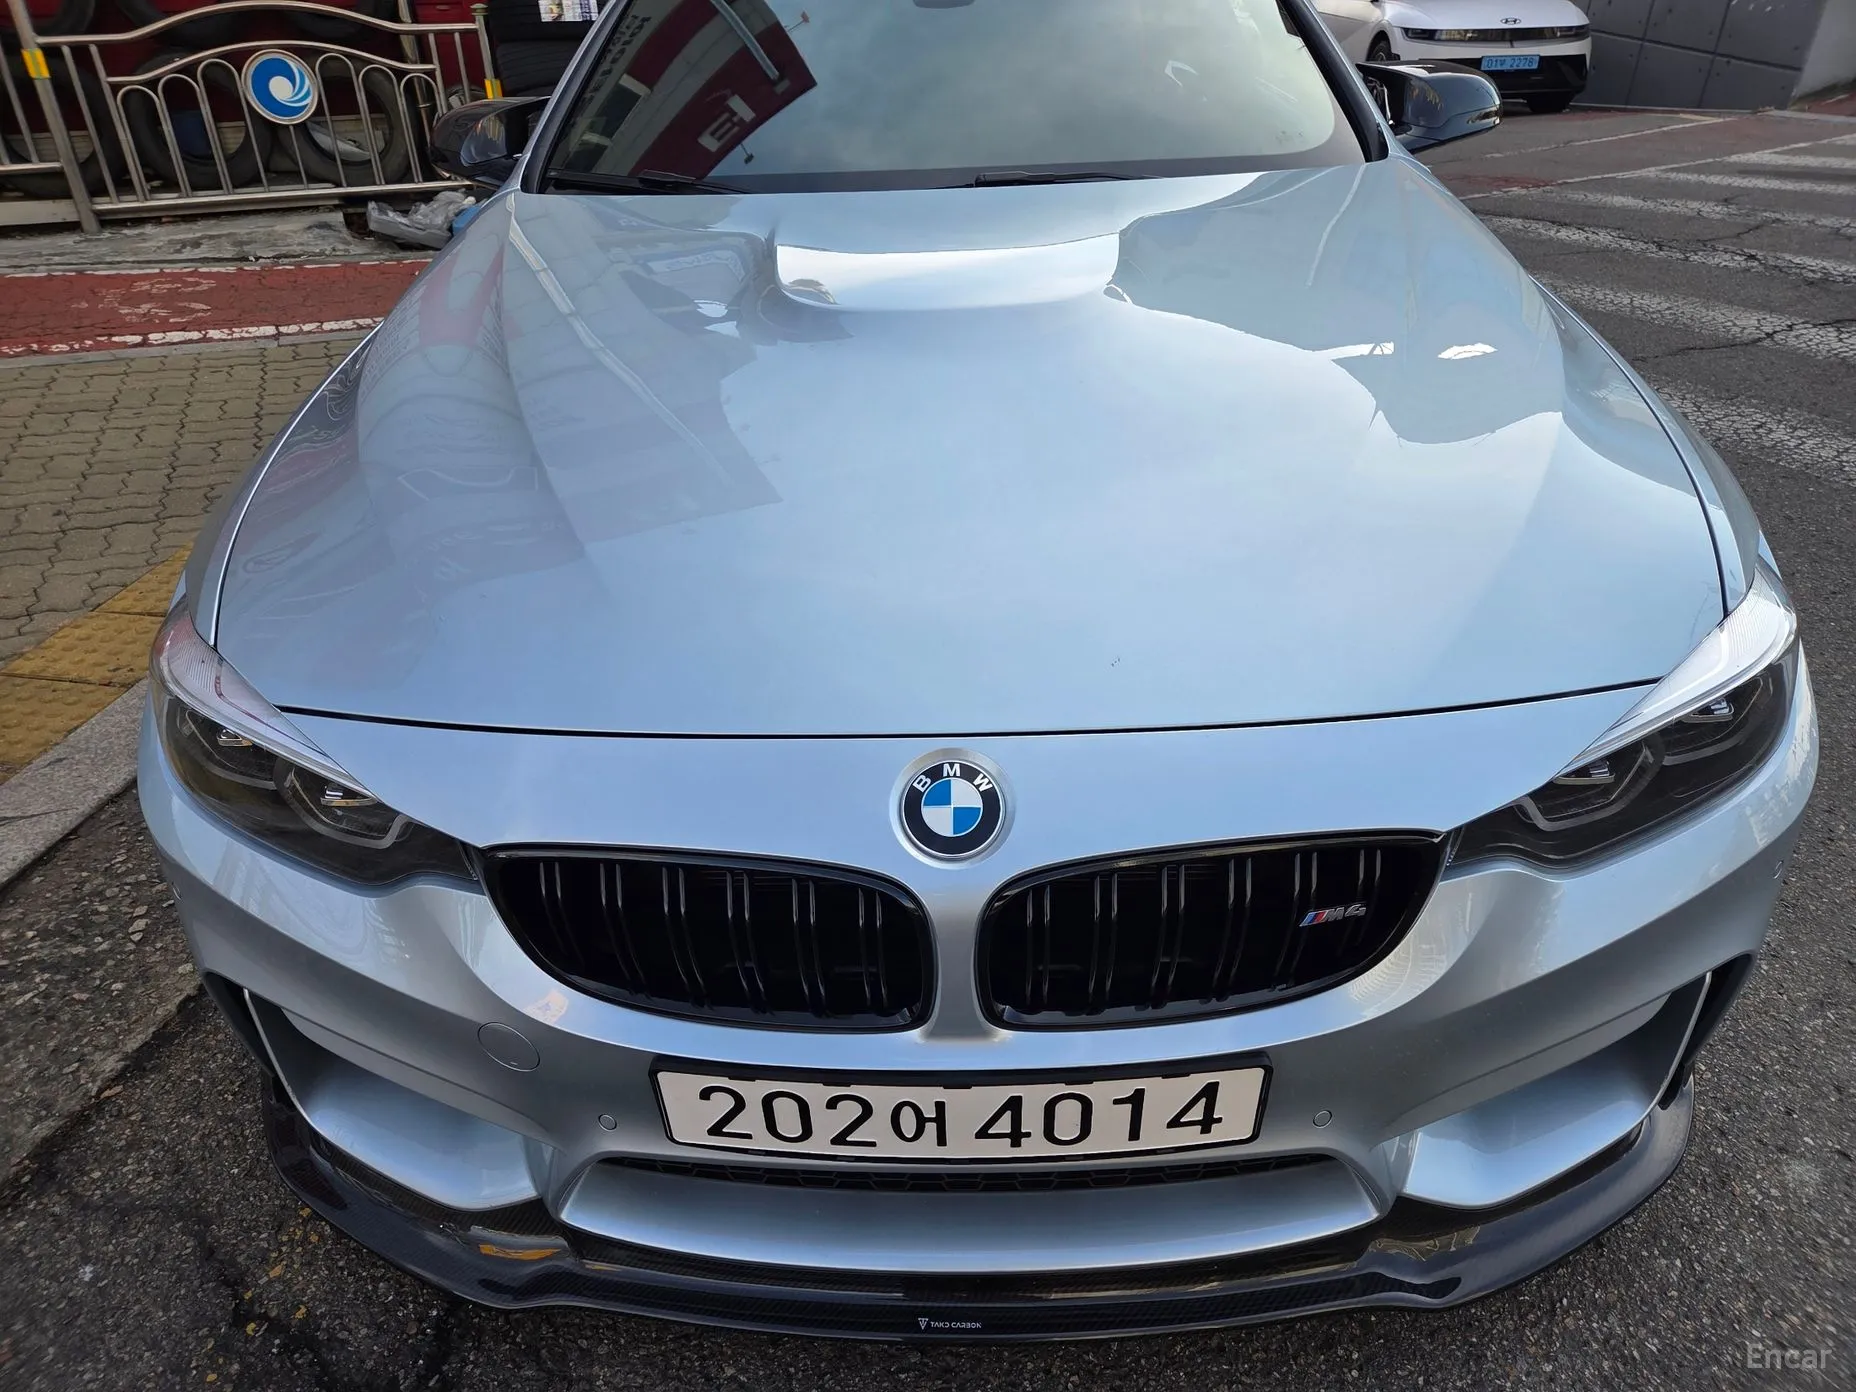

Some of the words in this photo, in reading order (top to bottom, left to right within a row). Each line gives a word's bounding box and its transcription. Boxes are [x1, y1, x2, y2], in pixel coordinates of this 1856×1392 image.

[912, 763, 993, 793] BMW
[698, 1085, 948, 1148] 202어
[974, 1081, 1223, 1148] 4014
[951, 1321, 982, 1329] CARBON
